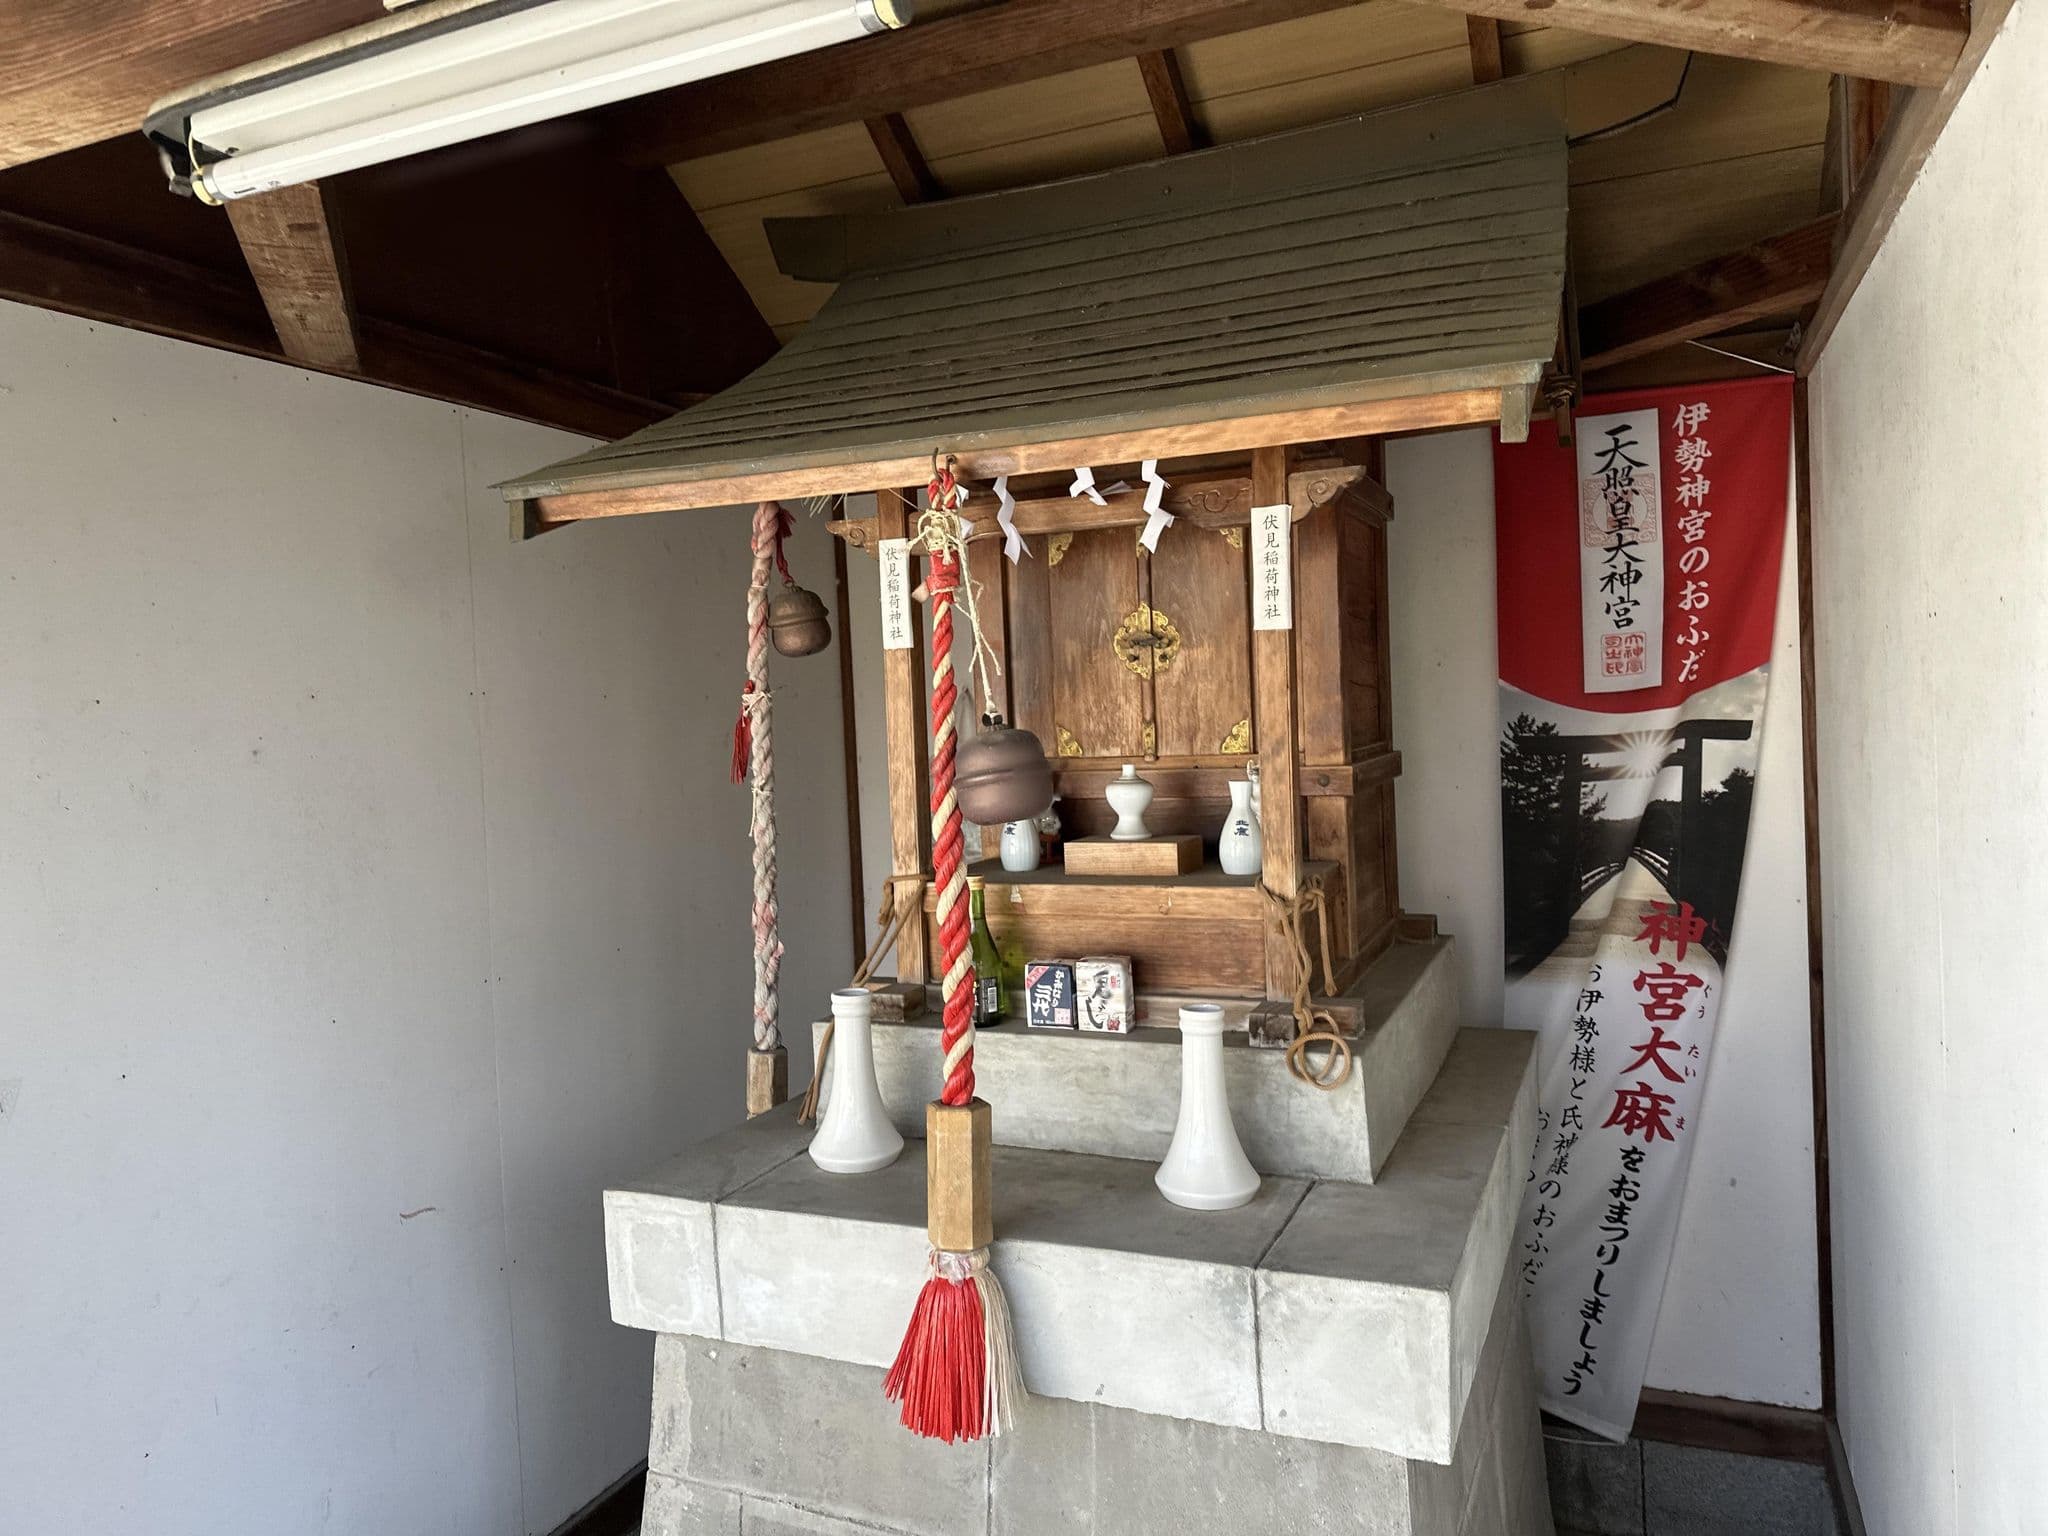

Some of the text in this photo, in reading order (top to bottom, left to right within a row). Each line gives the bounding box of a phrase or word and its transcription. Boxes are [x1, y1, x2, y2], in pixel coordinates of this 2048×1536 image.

[885, 547, 904, 640] 伏見稲荷神社
[1262, 514, 1281, 620] 伏見稲荷神社
[1593, 423, 1650, 630] 天照皇大神宮
[1672, 401, 1713, 684] 伊勢神宮のおふだ
[1600, 899, 1708, 1143] 神宮大麻
[1562, 1144, 1647, 1396] をおまつりしましょう
